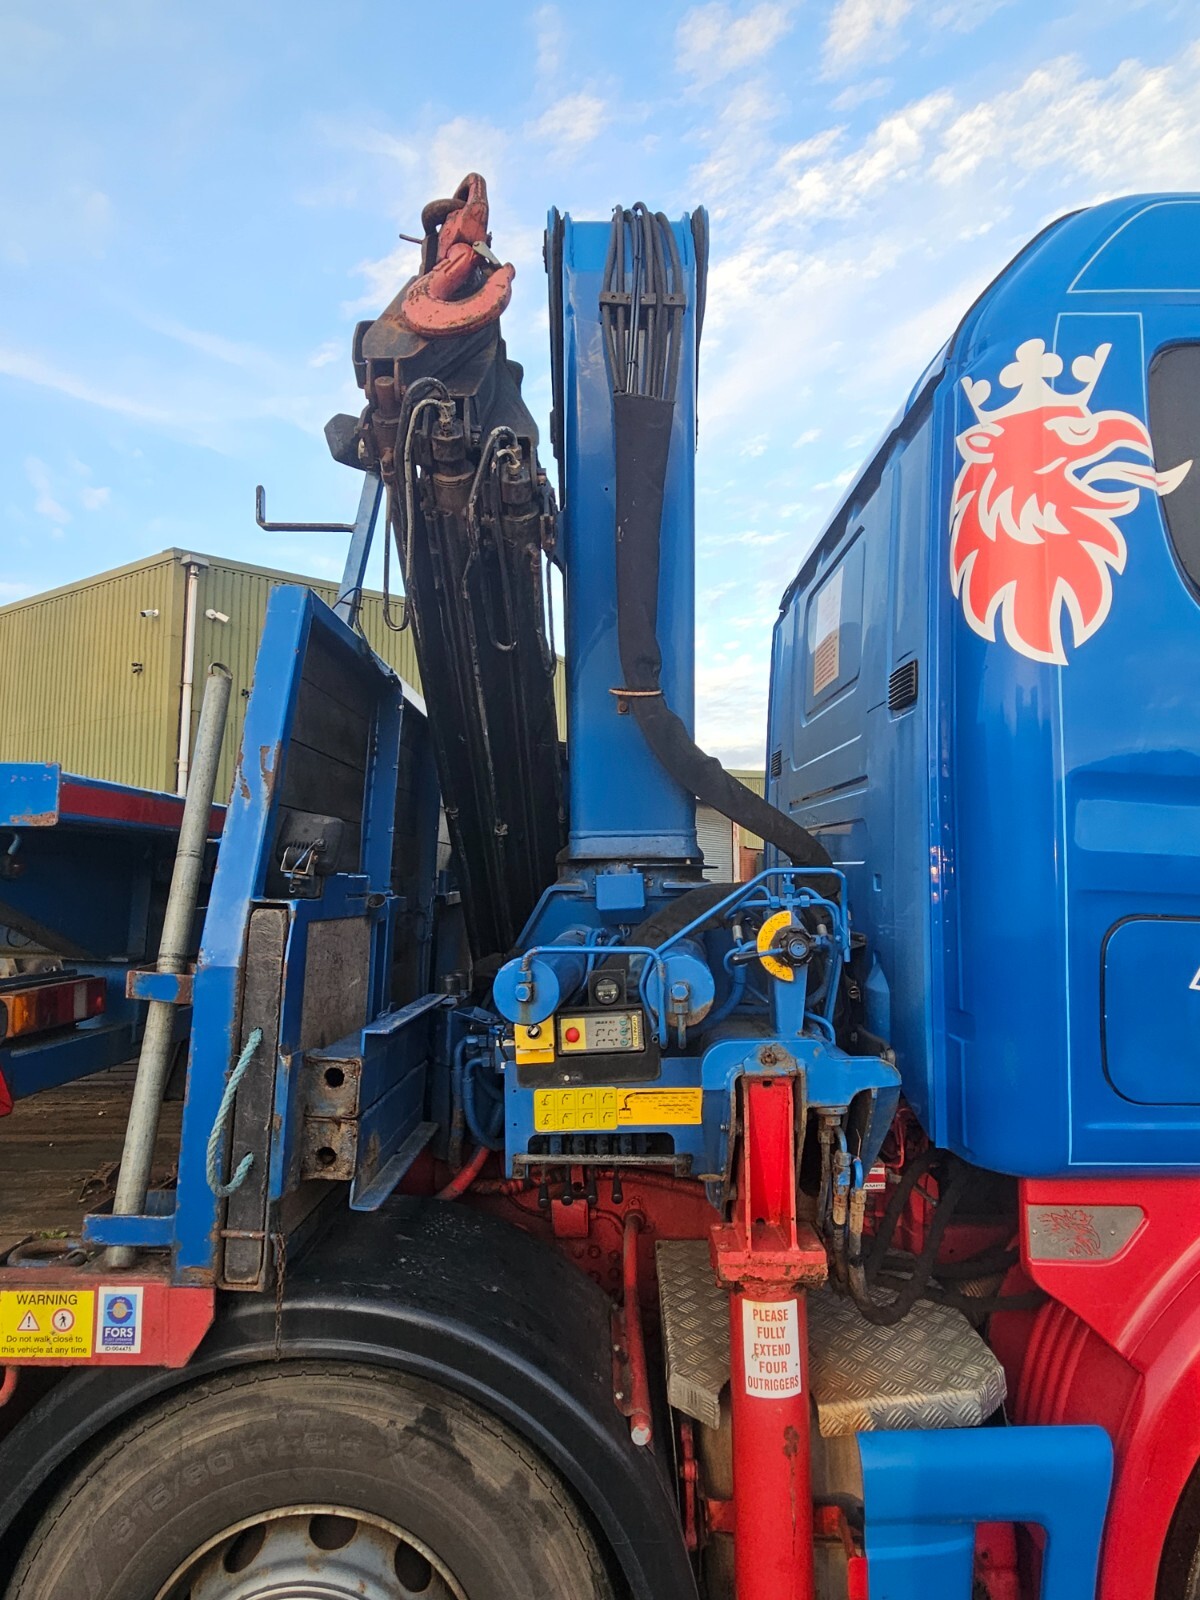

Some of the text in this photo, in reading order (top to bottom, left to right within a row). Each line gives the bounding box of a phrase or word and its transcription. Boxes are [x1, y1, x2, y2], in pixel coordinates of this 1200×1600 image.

[17, 1294, 78, 1305] WARNING
[752, 1309, 788, 1322] PLEASE
[105, 1327, 133, 1338] FORS
[757, 1326, 786, 1339] FULLY
[55, 1347, 69, 1355] any
[754, 1343, 790, 1356] EXTEND
[759, 1361, 788, 1374] FOUR
[747, 1375, 799, 1391] OUTRIGGERS
